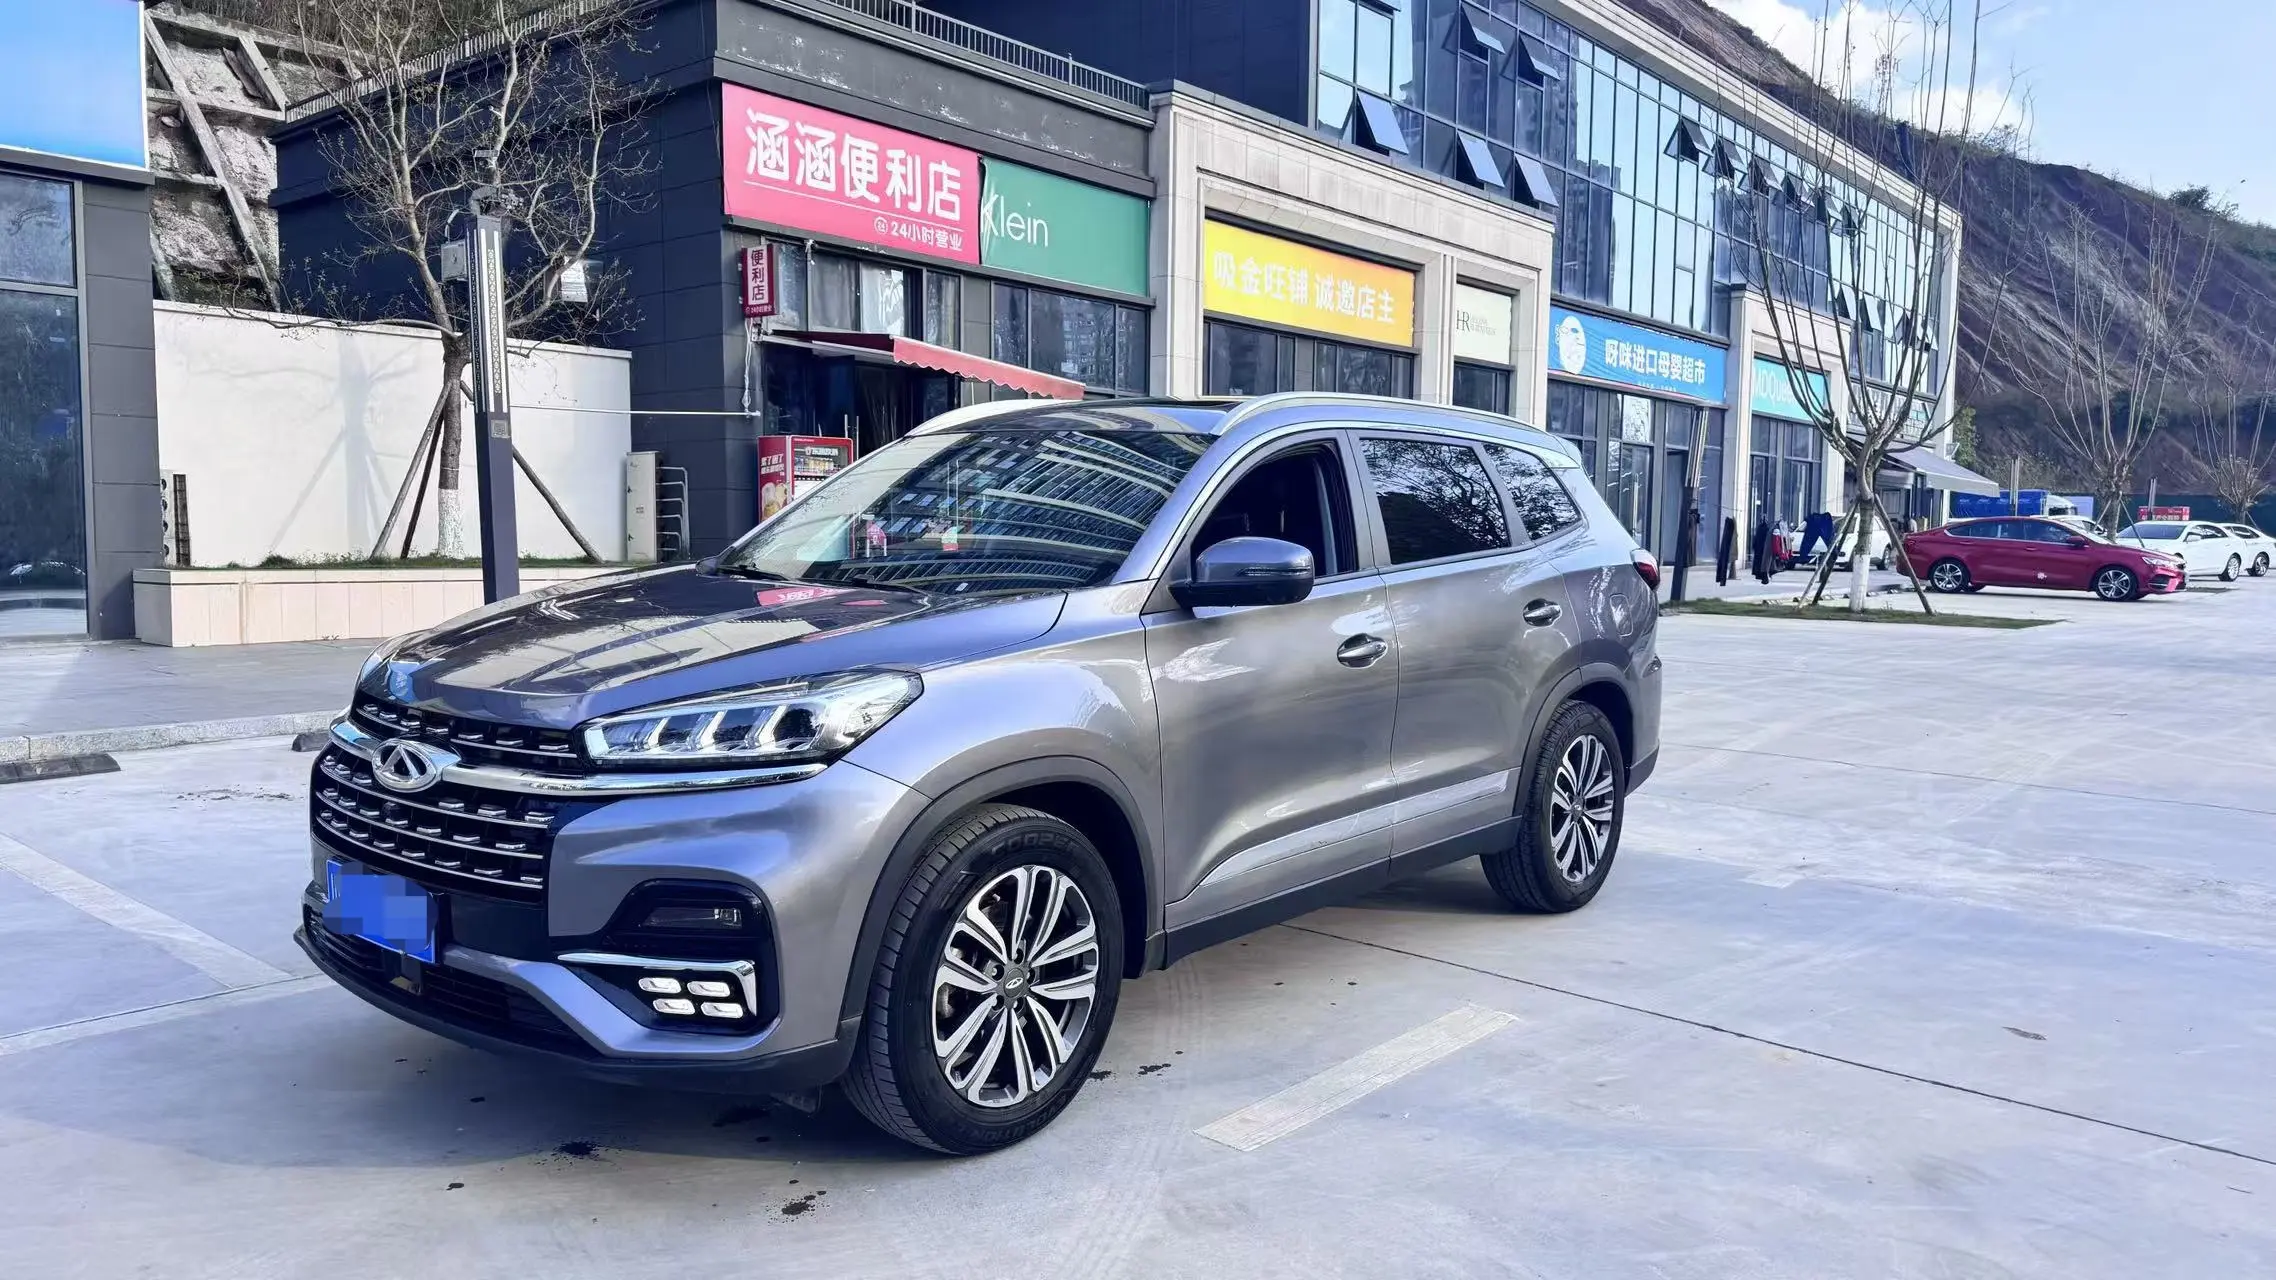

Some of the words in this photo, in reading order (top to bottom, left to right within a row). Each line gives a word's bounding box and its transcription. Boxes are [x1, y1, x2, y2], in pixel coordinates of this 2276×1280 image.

[745, 108, 962, 222] 涵涵便利店
[891, 221, 962, 251] 24小时营业
[980, 193, 1049, 247] Klein
[751, 249, 765, 301] 便利店
[1213, 251, 1309, 307] 吸金旺铺
[1314, 271, 1396, 324] 诚邀店主
